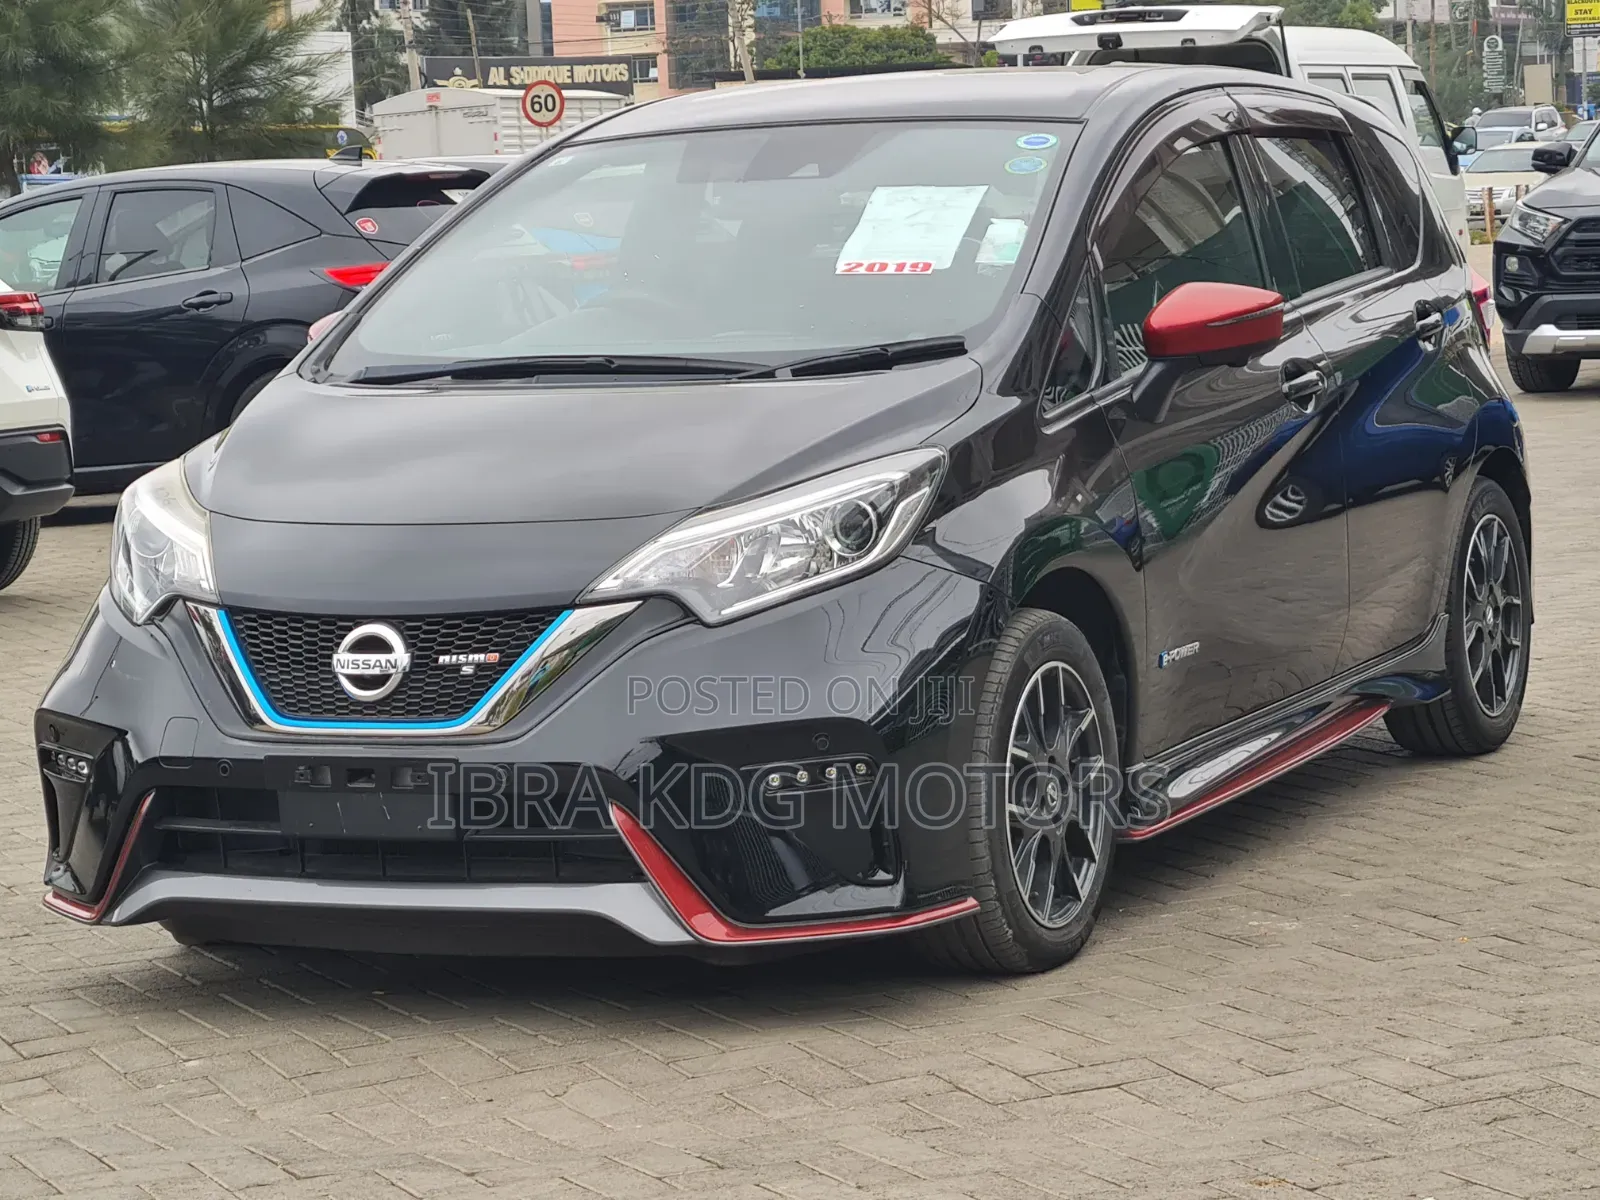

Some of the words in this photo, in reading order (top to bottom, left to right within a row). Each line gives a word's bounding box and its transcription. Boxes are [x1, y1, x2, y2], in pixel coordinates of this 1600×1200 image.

[488, 66, 509, 86] AL
[573, 64, 629, 83] MOTORS
[530, 94, 556, 113] 60
[840, 261, 933, 273] 2019
[335, 658, 398, 670] NISSAN
[460, 665, 476, 675] S
